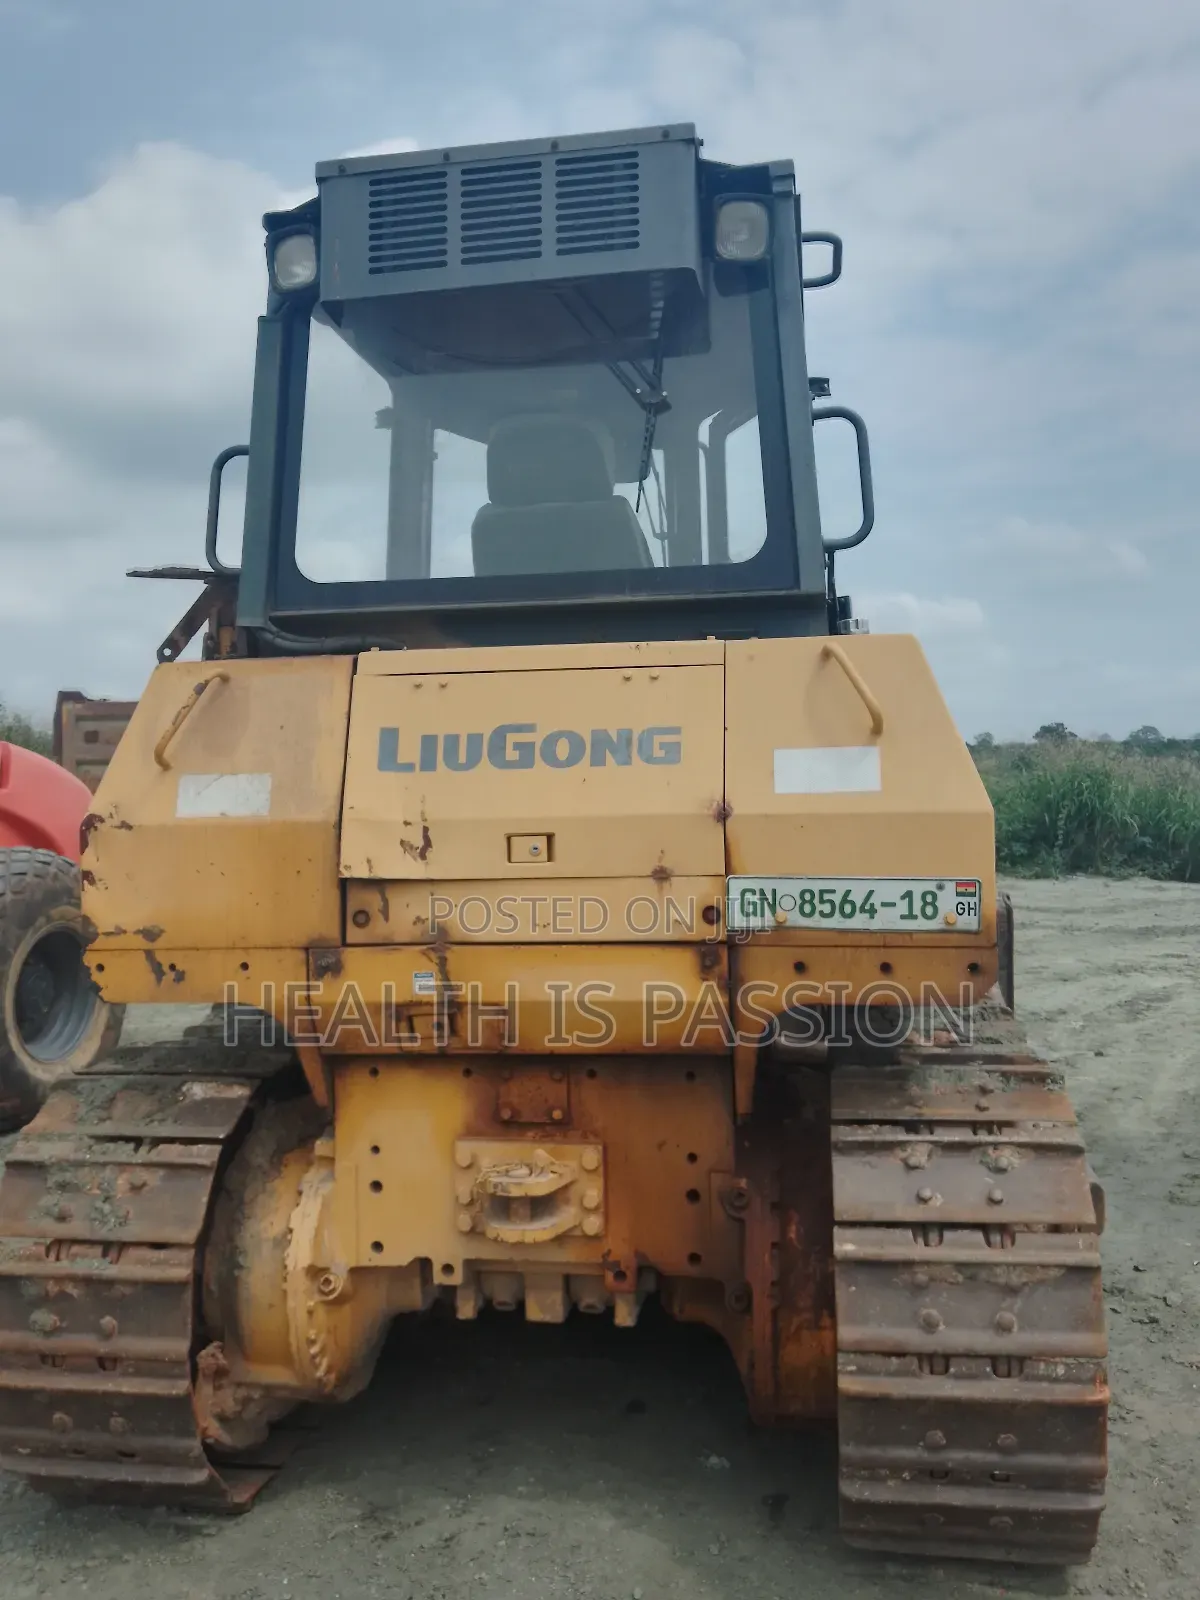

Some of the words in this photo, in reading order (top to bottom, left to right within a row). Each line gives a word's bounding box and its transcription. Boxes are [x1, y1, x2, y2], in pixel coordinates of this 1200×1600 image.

[739, 888, 777, 918] GN
[799, 888, 939, 920] 8564-18
[955, 901, 977, 917] GH
